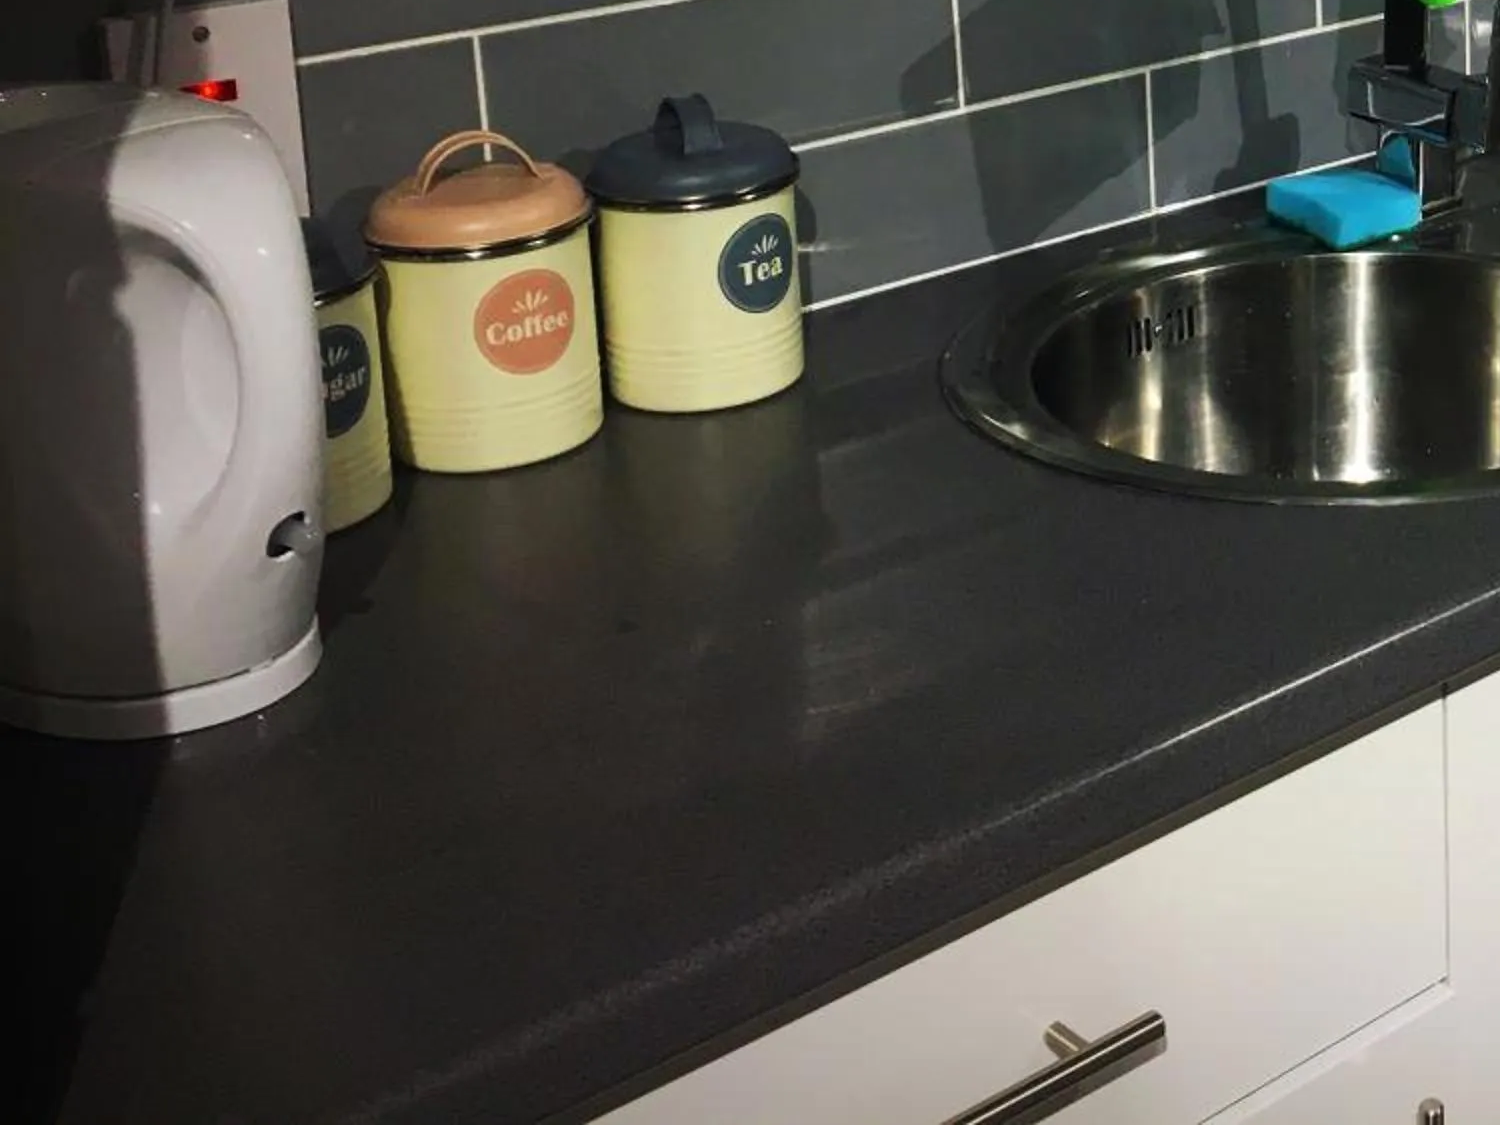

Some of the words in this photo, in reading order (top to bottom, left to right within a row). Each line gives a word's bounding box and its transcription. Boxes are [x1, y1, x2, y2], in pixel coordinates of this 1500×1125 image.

[737, 256, 784, 286] Tea
[485, 310, 569, 345] Coffee
[322, 366, 368, 402] gar
